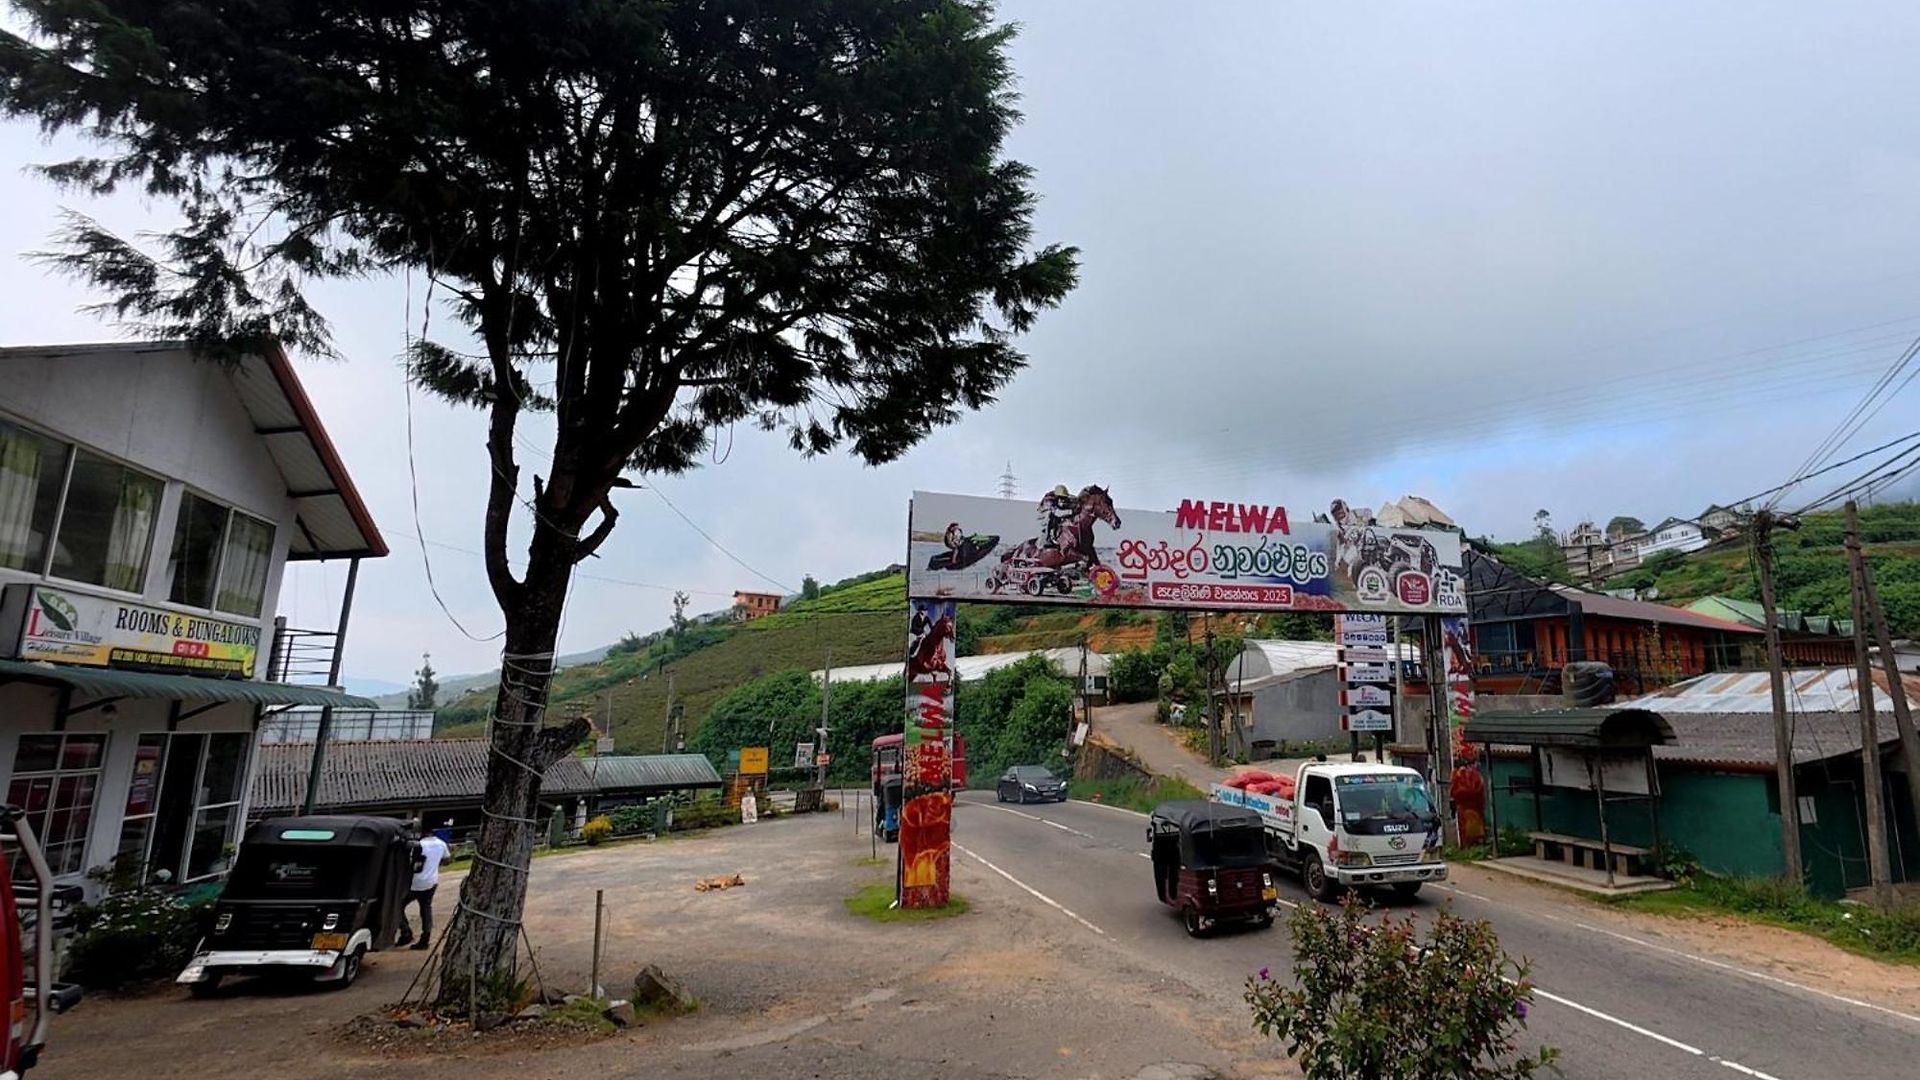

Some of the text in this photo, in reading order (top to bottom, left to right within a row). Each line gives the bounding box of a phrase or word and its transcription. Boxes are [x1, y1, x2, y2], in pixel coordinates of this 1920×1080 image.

[1175, 499, 1290, 535] MELWA
[1117, 533, 1209, 579] සුන්දර
[1263, 590, 1287, 601] 2025
[1439, 595, 1462, 606] RDA
[116, 608, 259, 646] ROOMS & BUNGALOWS
[919, 683, 945, 785] MELWA
[1383, 823, 1409, 833] ISUZU
